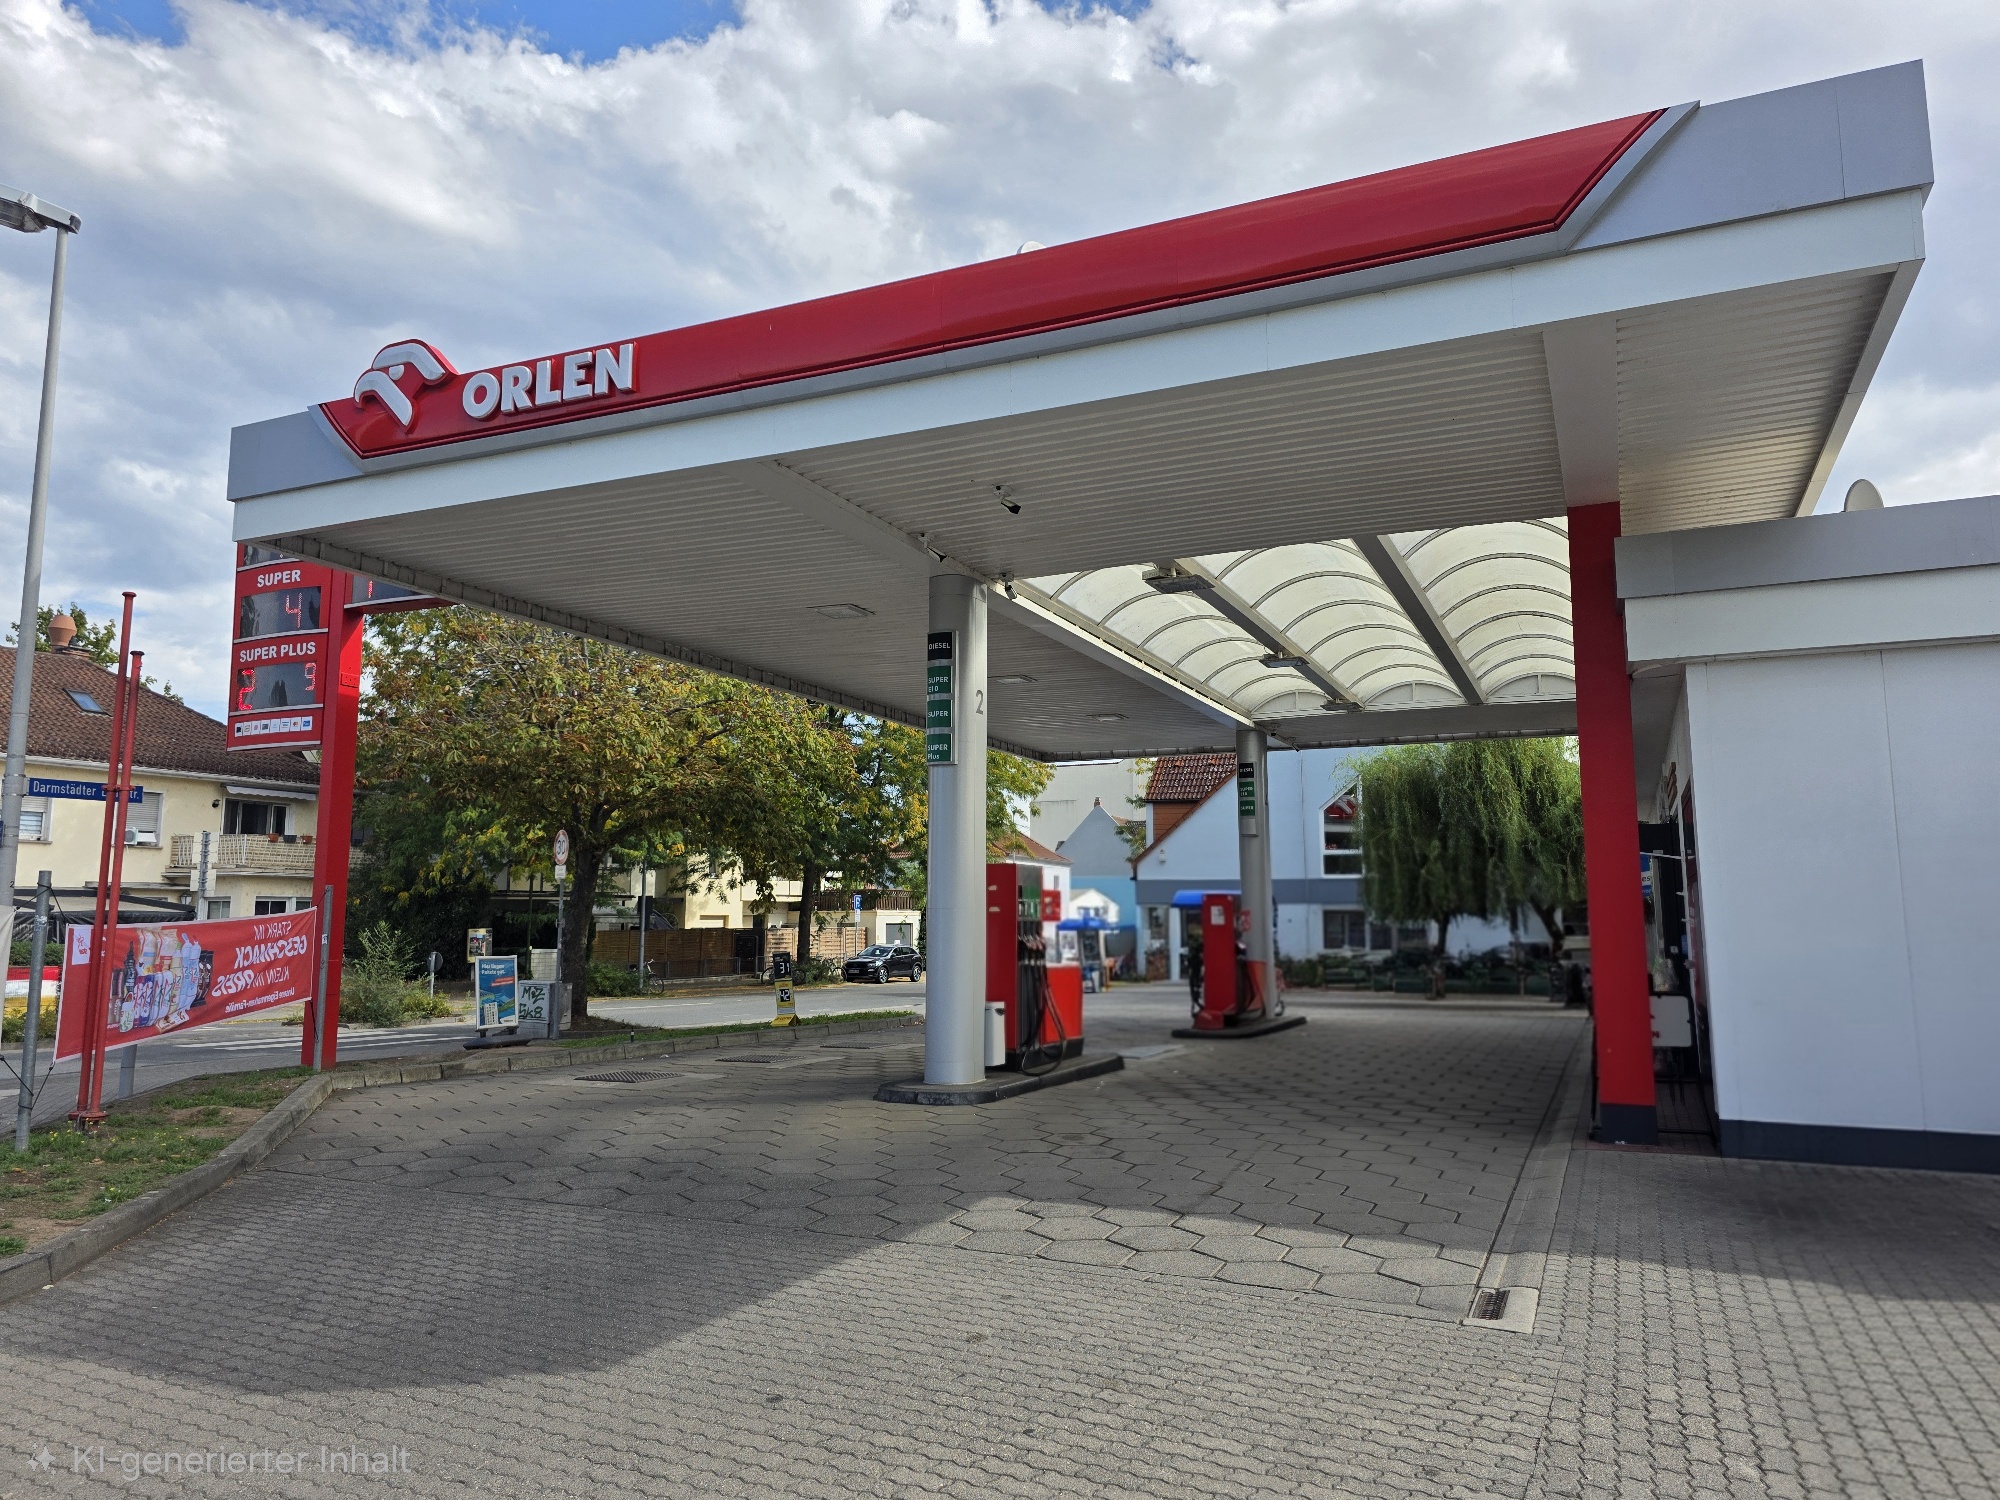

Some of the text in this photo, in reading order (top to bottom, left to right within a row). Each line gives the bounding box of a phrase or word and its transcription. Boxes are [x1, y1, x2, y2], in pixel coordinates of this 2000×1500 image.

[462, 343, 634, 419] ORLEN
[256, 569, 301, 588] SUPER
[285, 592, 303, 629] 4
[239, 641, 316, 663] SUPER PLUS
[928, 642, 951, 650] DIESEL
[928, 676, 949, 684] SUPER
[975, 689, 984, 716] 2
[927, 710, 949, 718] SUPER
[927, 743, 948, 751] SUPER
[33, 780, 97, 797] Darmstädter
